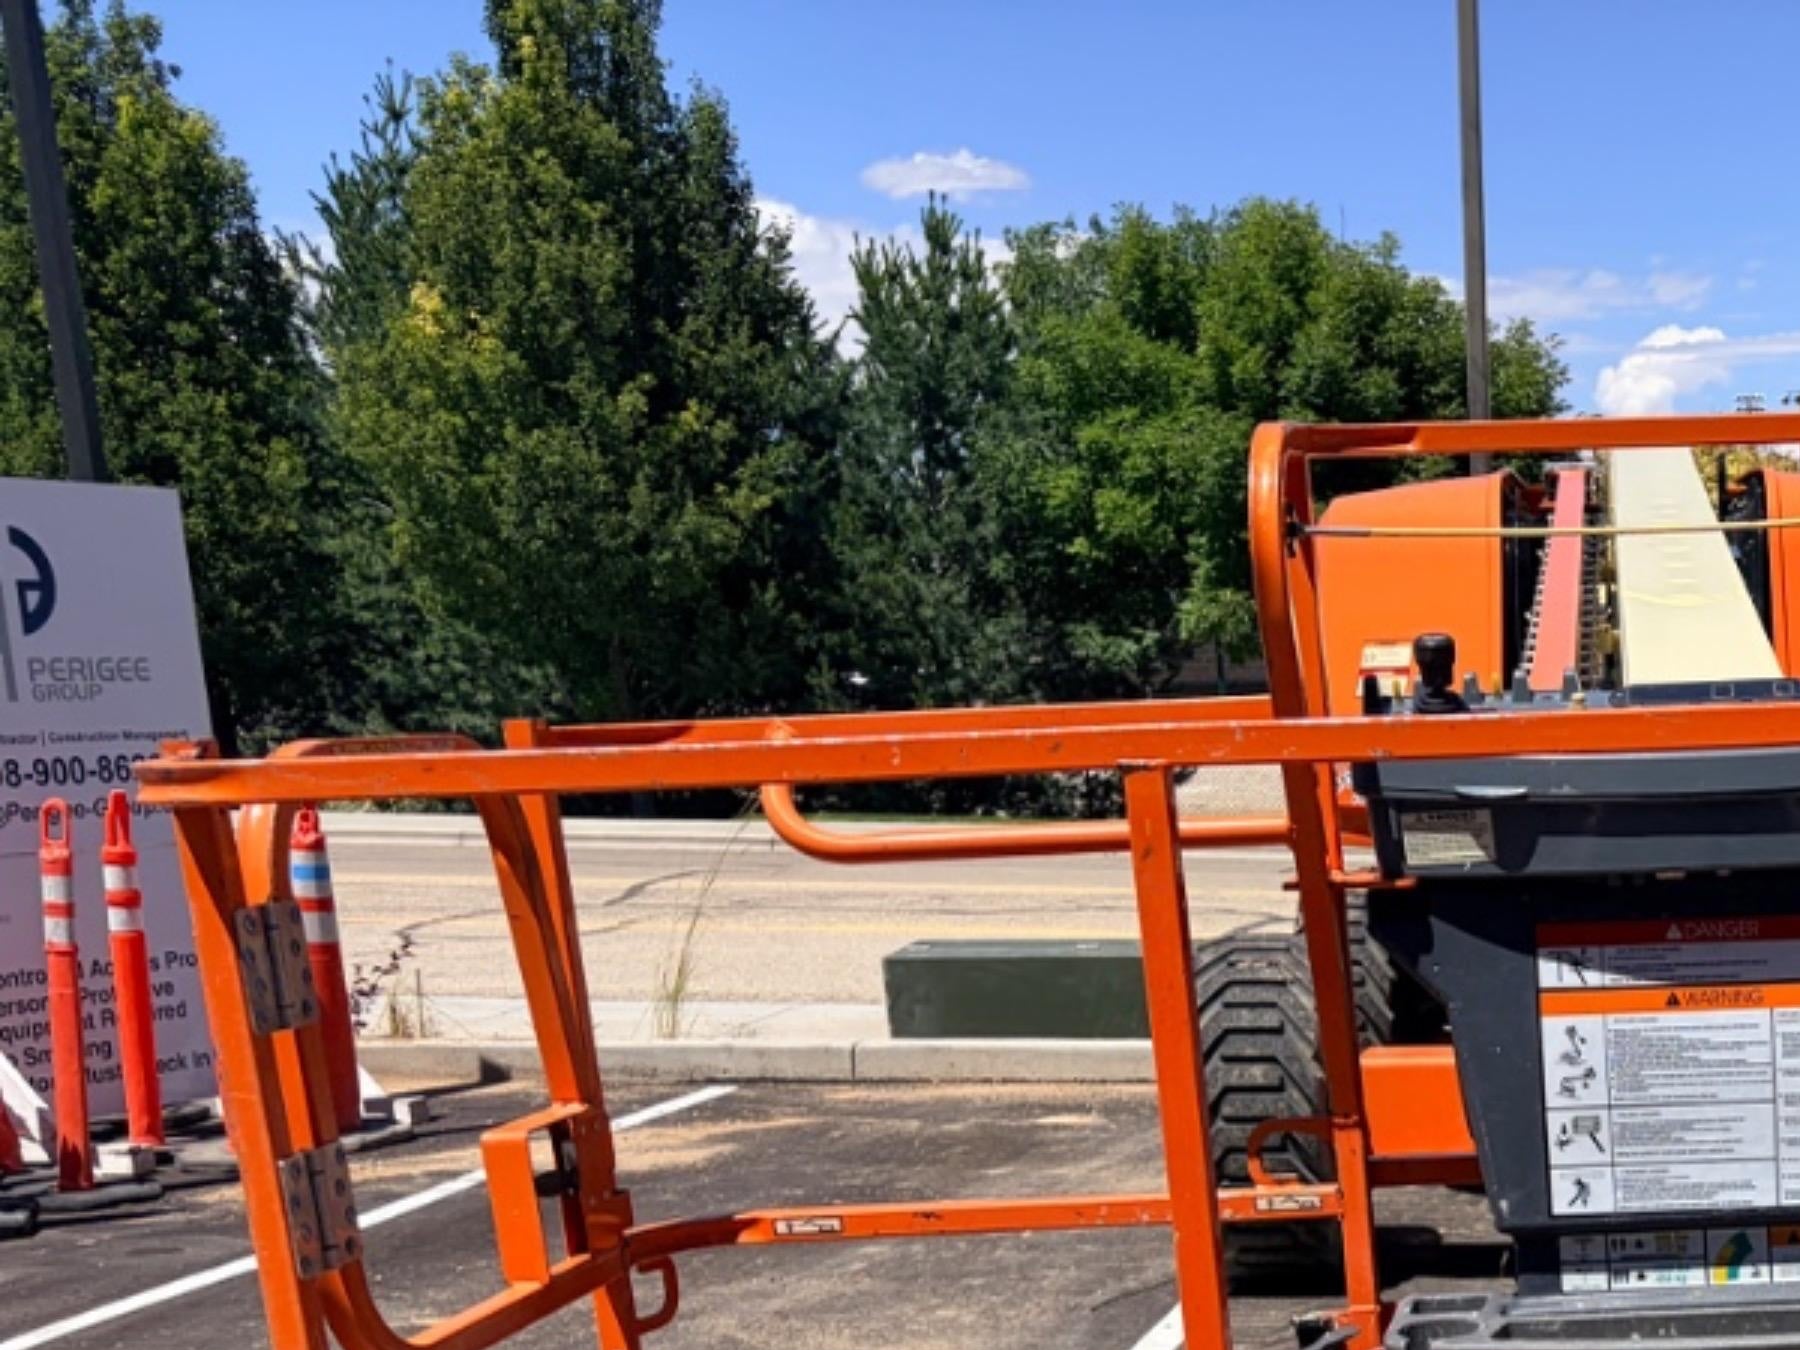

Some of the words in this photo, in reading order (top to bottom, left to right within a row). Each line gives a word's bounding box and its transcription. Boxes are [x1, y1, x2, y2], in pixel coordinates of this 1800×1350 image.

[27, 656, 152, 682] PERIGEE
[32, 683, 103, 702] GROUP
[0, 752, 160, 789] 8-900-86
[1683, 919, 1760, 938] DANGER
[1682, 989, 1764, 1008] WARNING
